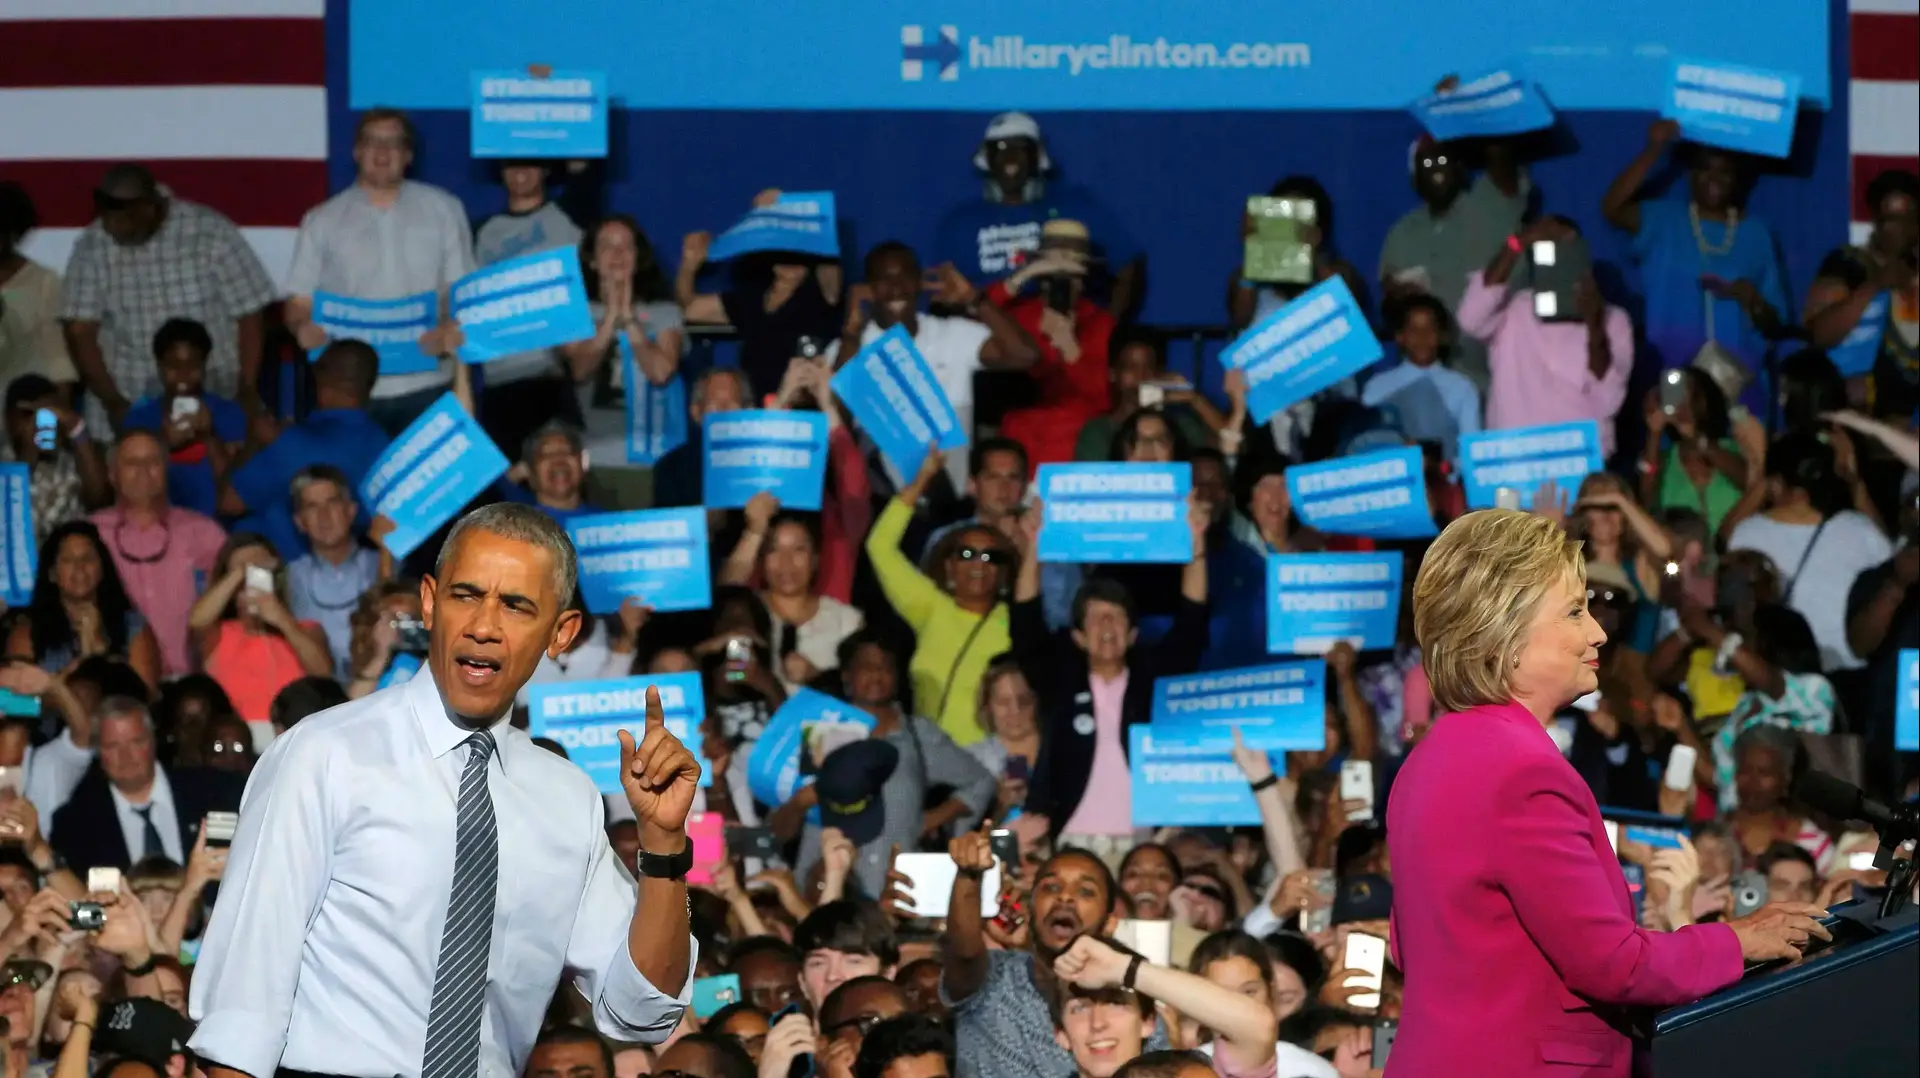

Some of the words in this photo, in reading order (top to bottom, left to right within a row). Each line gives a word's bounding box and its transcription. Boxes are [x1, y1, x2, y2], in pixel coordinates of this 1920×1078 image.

[969, 34, 1310, 76] hillaryclinton.com
[481, 78, 591, 98] STRONGER
[1676, 65, 1786, 99] STRONGER
[481, 103, 591, 122] TOGETHER
[1674, 88, 1782, 123] TOGETHER
[455, 259, 564, 303] STRONGER
[455, 285, 571, 325] TOGETHER
[1231, 292, 1337, 367] STRONGER
[1245, 316, 1352, 387] TOGETHER
[709, 420, 813, 442] STRONGER
[1469, 430, 1584, 461] STRONGER
[366, 411, 456, 500] STRONGER
[710, 448, 811, 469] TOGETHER
[1474, 455, 1588, 486] TOGETHER
[375, 433, 473, 514] TOGETHER
[1049, 472, 1175, 495] STRONGER
[1297, 458, 1408, 495] STRONGER
[1050, 502, 1175, 523] TOGETHER
[1303, 487, 1411, 520] TOGETHER
[576, 520, 689, 547] STRONGER
[582, 547, 691, 576] TOGETHER
[1278, 563, 1390, 585] STRONGER
[1278, 591, 1388, 613] TOGETHER
[1166, 668, 1306, 695] STRONGER
[1166, 688, 1305, 715] TOGETHER
[545, 718, 690, 749] TOGER
[1142, 762, 1247, 784] TOGETH
